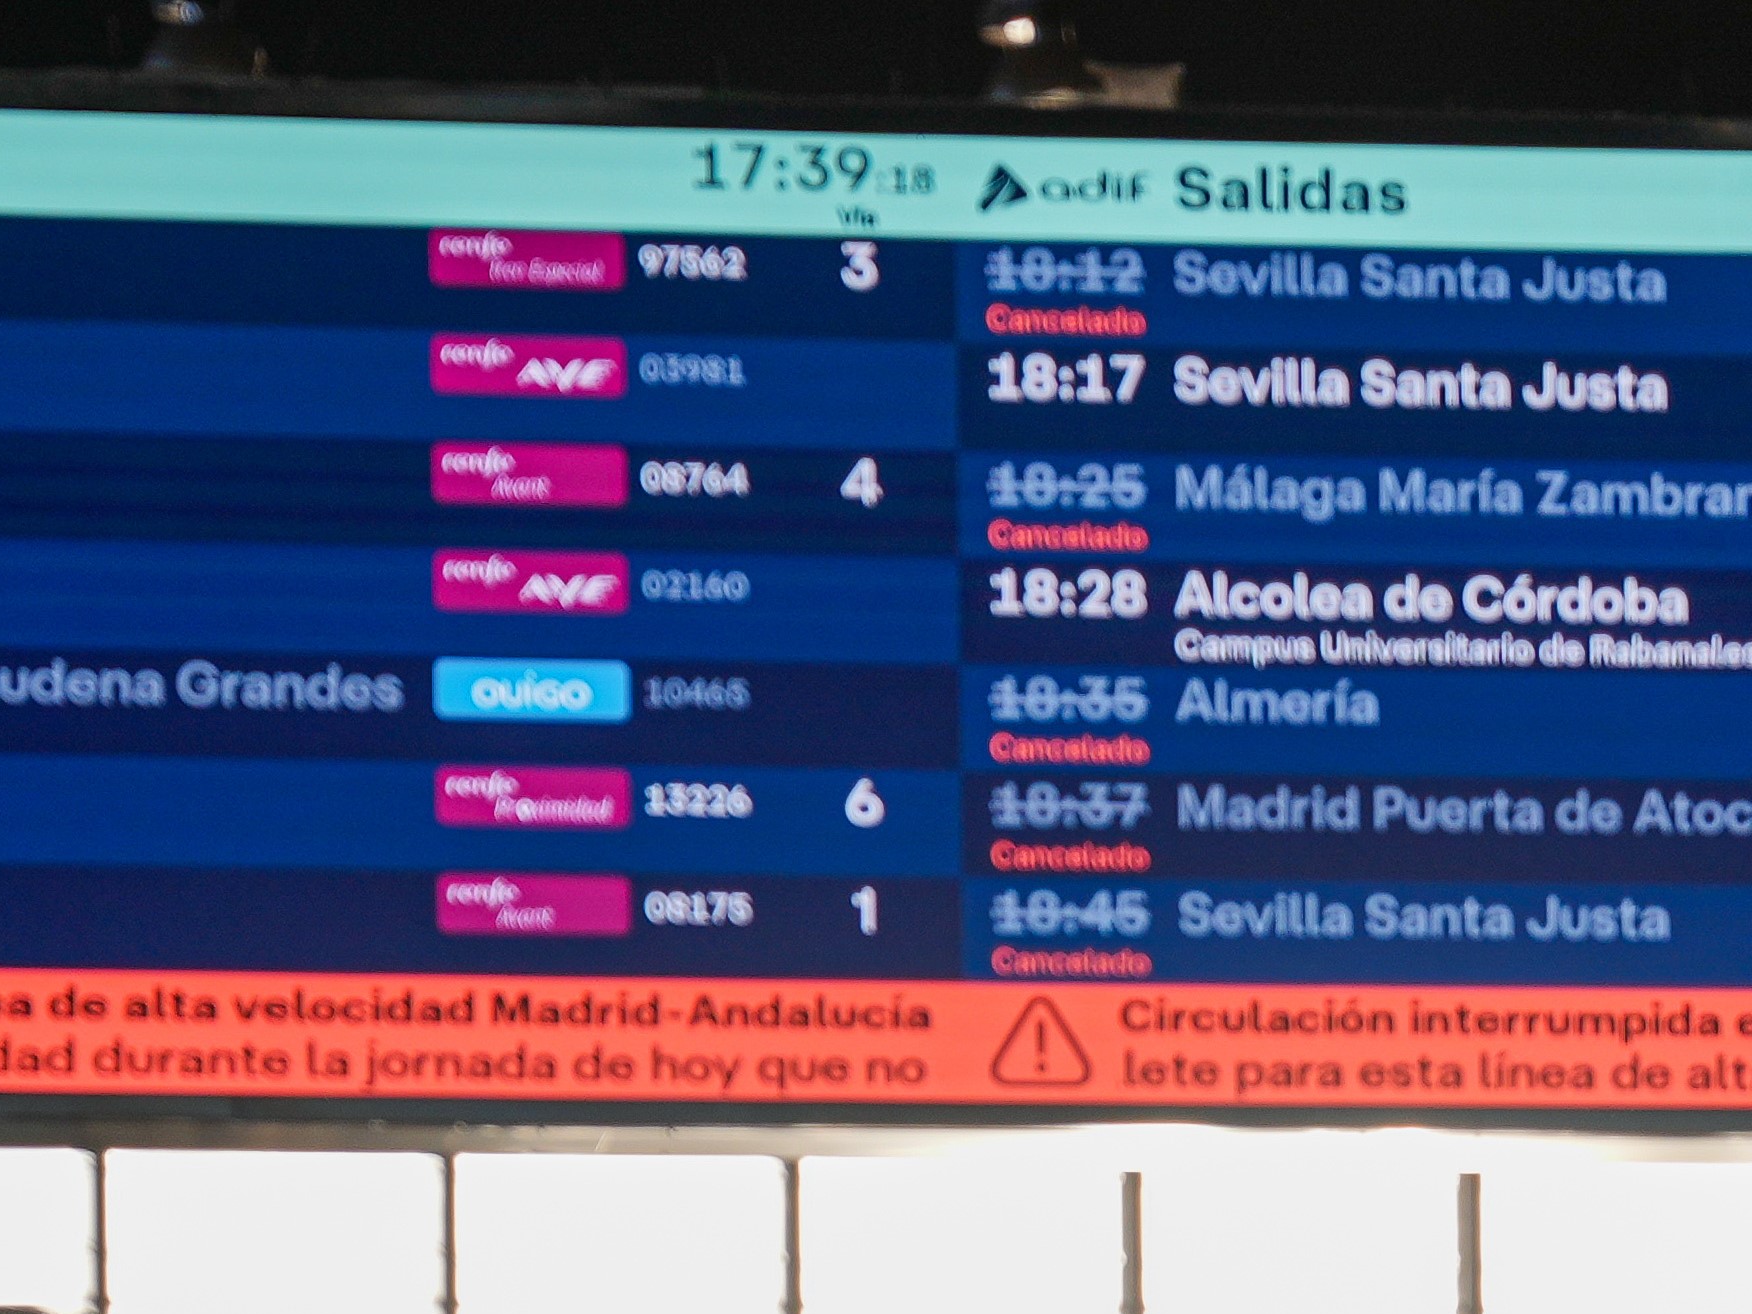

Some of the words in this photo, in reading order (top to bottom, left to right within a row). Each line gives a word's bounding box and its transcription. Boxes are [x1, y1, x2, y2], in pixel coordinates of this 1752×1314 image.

[1037, 170, 1144, 203] adif
[1176, 166, 1406, 216] Salidas
[638, 243, 747, 281] 97562
[840, 240, 878, 291] 3
[987, 352, 1144, 403] 18:17
[1173, 355, 1350, 406] Sevilla
[1361, 358, 1511, 409] Santa
[1522, 361, 1669, 412] Justa
[842, 458, 881, 508] 4
[989, 569, 1147, 619] 18:28
[1173, 570, 1373, 623] Alcolea
[1384, 573, 1451, 622] de
[1462, 575, 1689, 625] Córdoba
[1173, 628, 1316, 669] Campus
[1320, 630, 1534, 667] Universitario
[1539, 633, 1584, 667] de
[177, 659, 403, 715] Grandes
[1175, 677, 1380, 725] Almería
[644, 782, 752, 818] 13226
[845, 777, 885, 828] 6
[851, 886, 877, 935] 1
[1120, 997, 1395, 1034] Circulación
[1409, 1002, 1720, 1042] interrumpida
